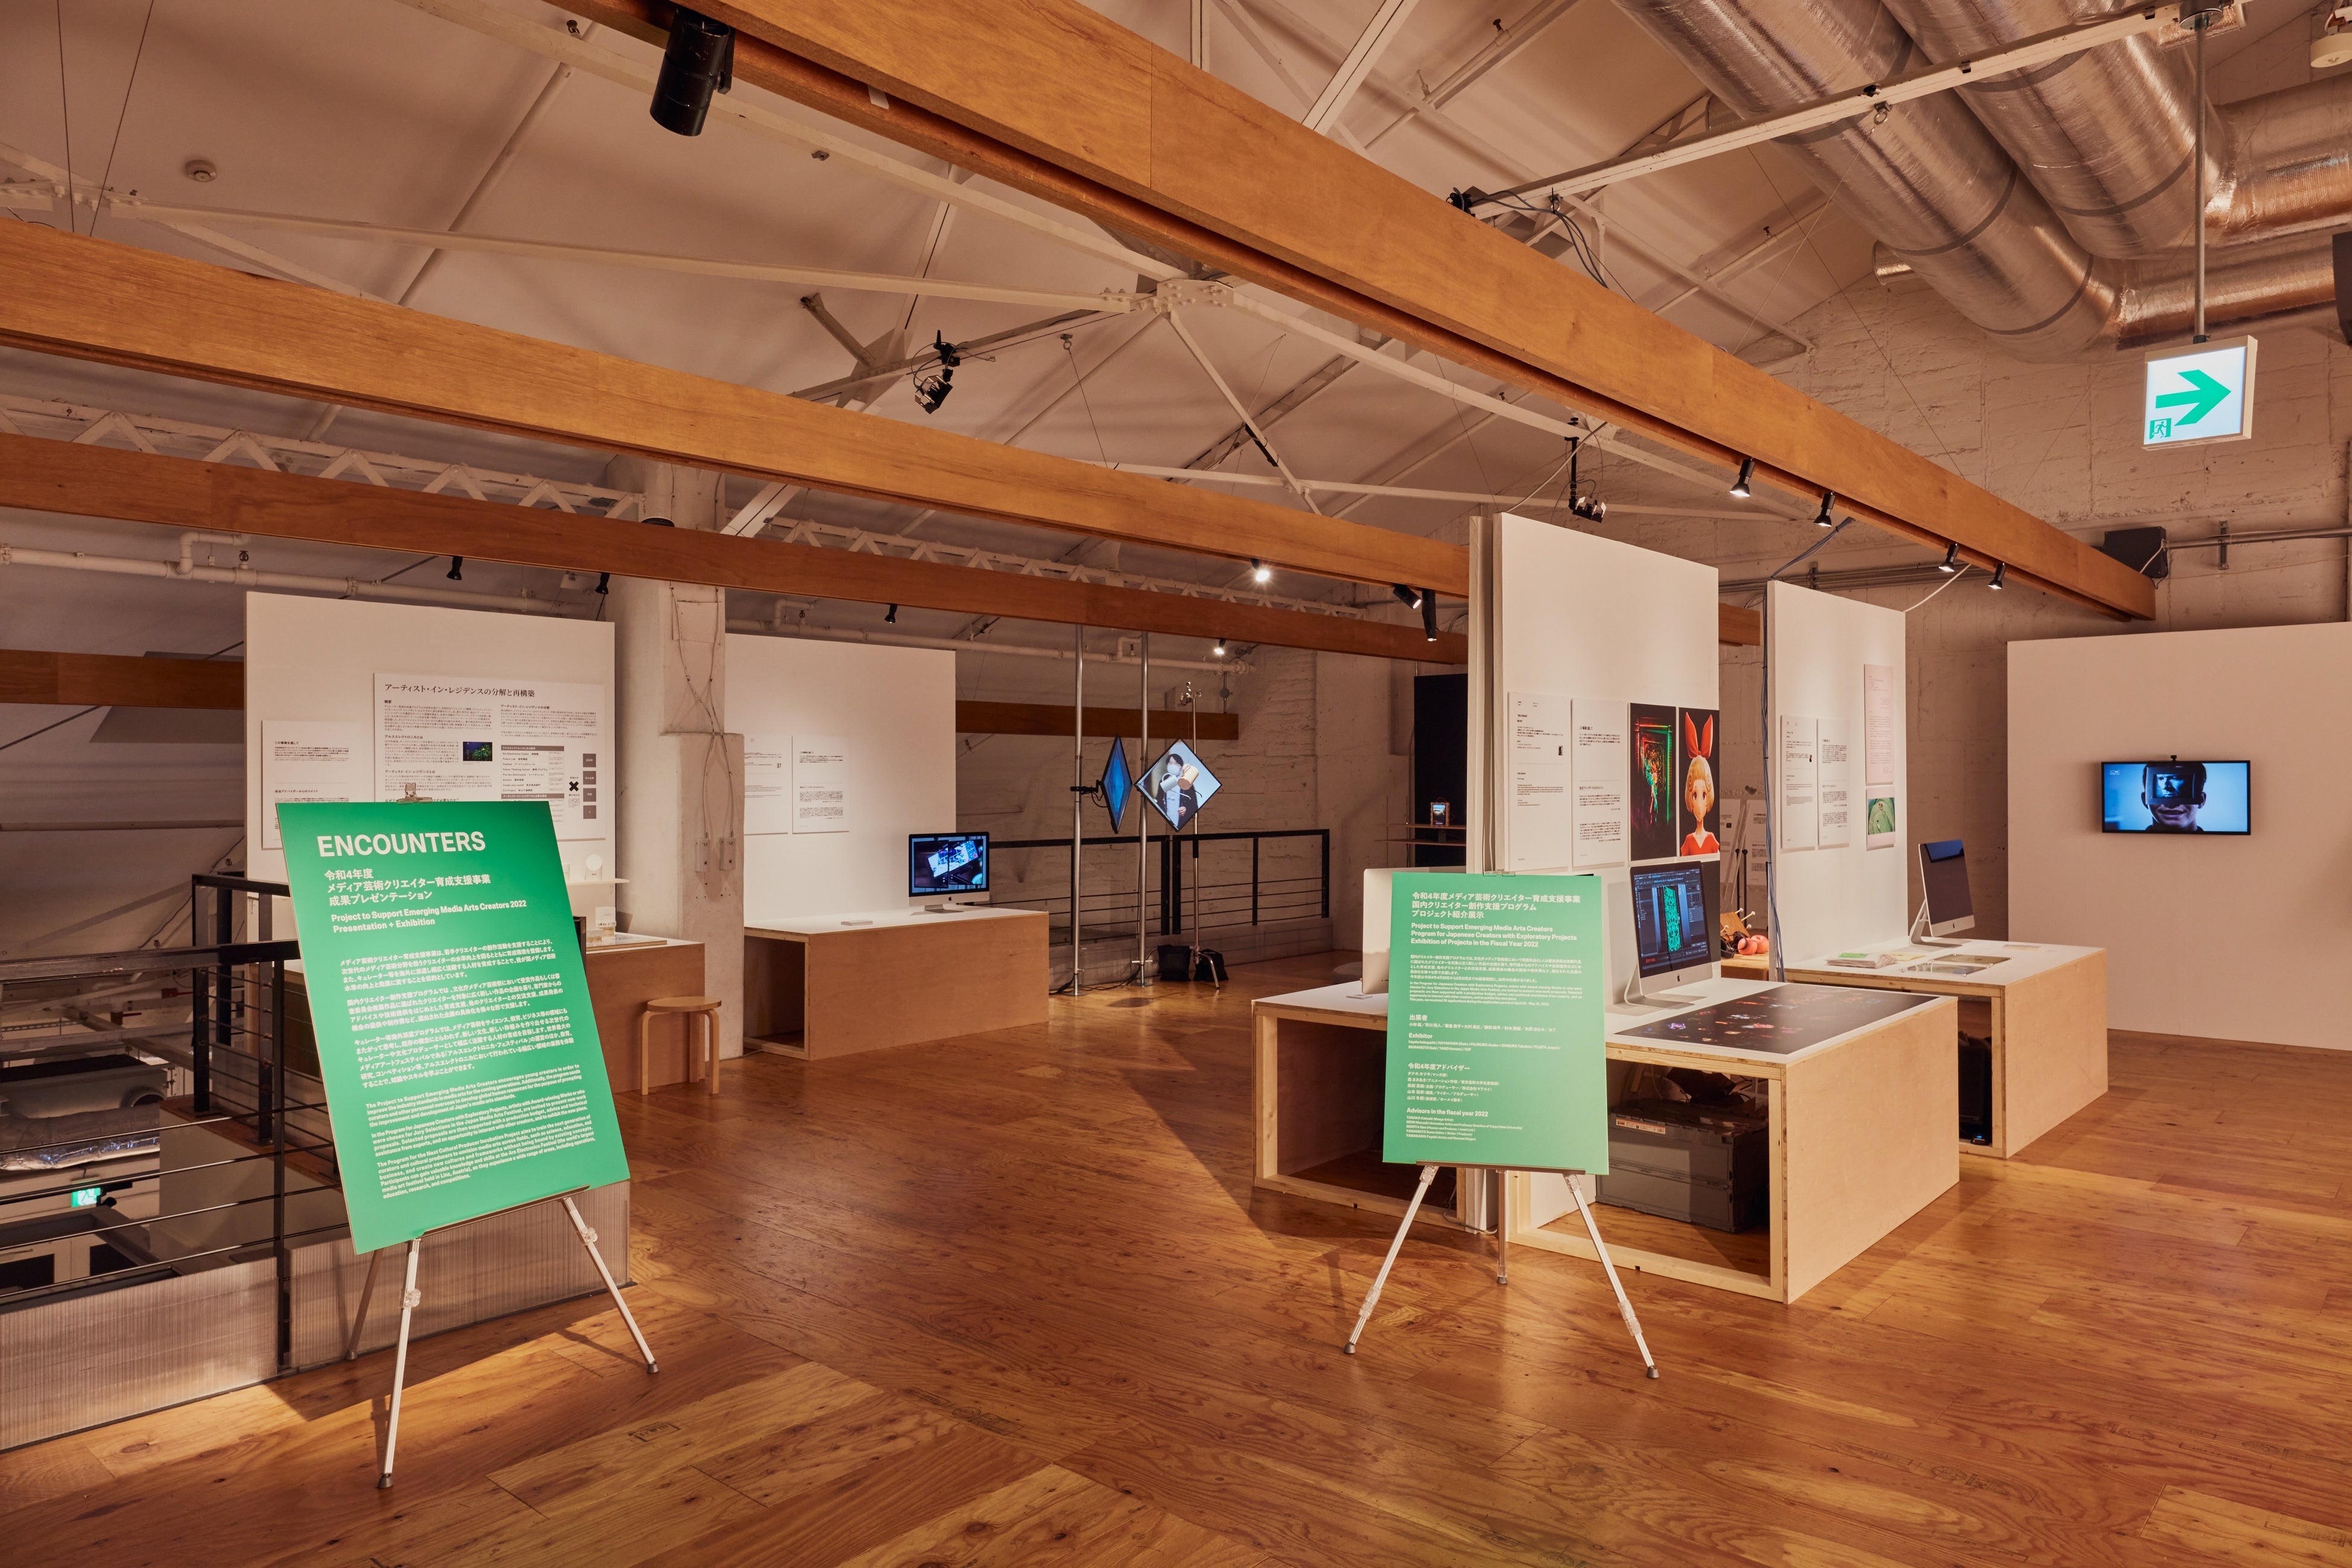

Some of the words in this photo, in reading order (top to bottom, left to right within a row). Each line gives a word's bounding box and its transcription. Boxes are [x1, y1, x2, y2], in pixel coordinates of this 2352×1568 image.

[385, 684, 534, 698] アーティスト・イン・レジデンスの分解と再構築
[317, 831, 485, 857] ENCOUNTERS
[324, 868, 373, 880] 令和4年度
[327, 873, 491, 893] メディア芸術クリエイター育成支援事業
[329, 891, 432, 906] 成果プレゼンテーション
[1412, 891, 1579, 903] 令和4年度メディア芸術クリエイター育成支援事業
[330, 913, 361, 922] Project
[371, 909, 402, 919] Support
[403, 907, 440, 916] Emerging
[440, 905, 463, 913] Media
[479, 902, 510, 911] Creators
[510, 899, 527, 908] 2022
[1412, 900, 1536, 910] 国内クリエイター創作支援プログラム
[1412, 909, 1484, 918] プロジェクト紹介展示
[332, 922, 387, 933] Presentation
[395, 918, 435, 928] Exhibition
[498, 1075, 524, 1083] encourages
[539, 1068, 557, 1076] creators
[425, 1124, 450, 1133] Selections
[438, 1145, 458, 1153] Cultural
[479, 1135, 504, 1143] Incubation
[564, 1116, 586, 1125] generation
[383, 1189, 408, 1199] education,
[409, 1183, 431, 1192] research,
[440, 1174, 470, 1184] competitions.
